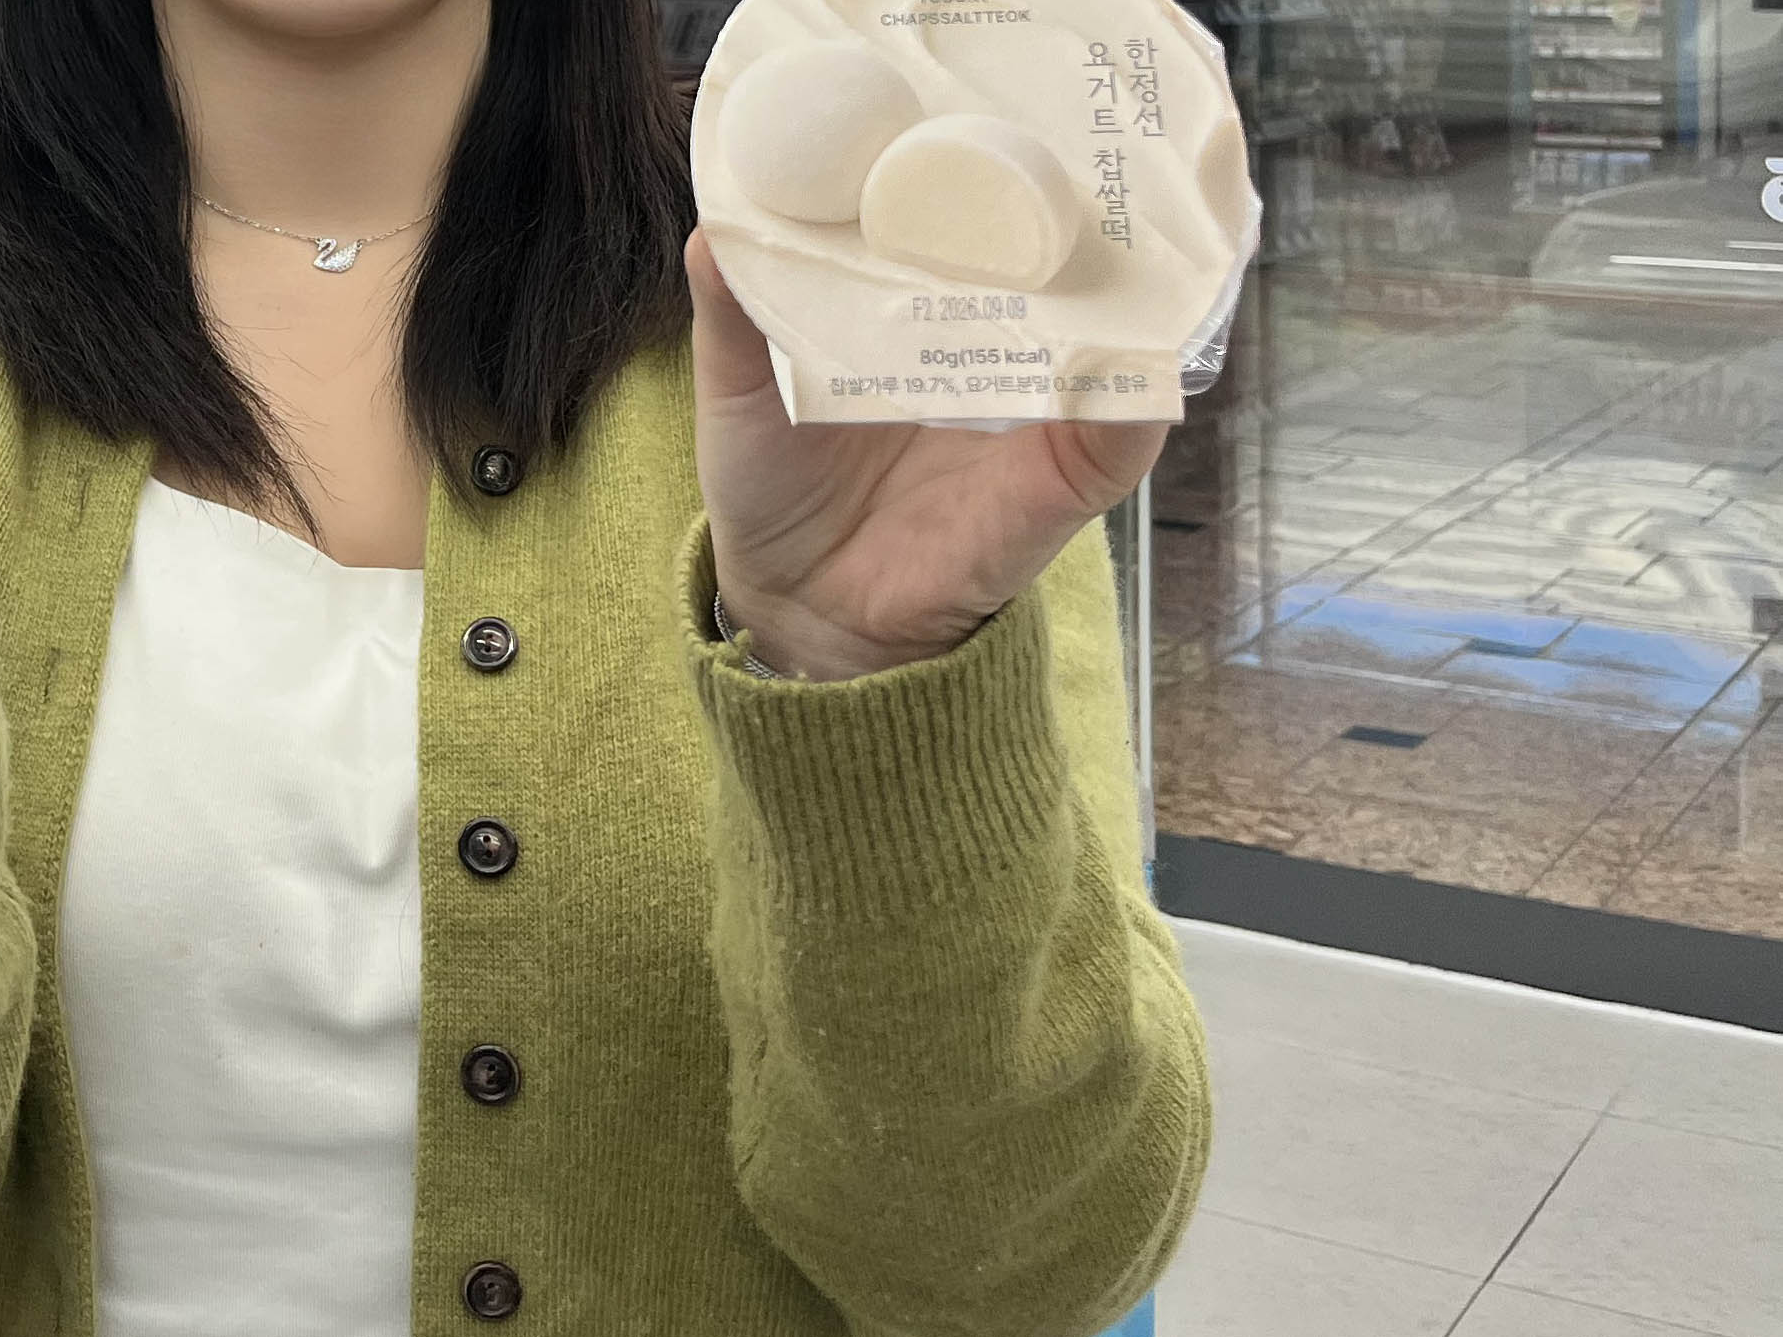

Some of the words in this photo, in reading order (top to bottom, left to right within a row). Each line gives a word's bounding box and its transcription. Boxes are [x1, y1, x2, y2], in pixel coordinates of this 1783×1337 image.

[1082, 42, 1125, 134] 요거트
[1124, 37, 1166, 137] 한정선
[1093, 148, 1132, 250] 찹쌀떡
[912, 297, 933, 321] F2
[830, 375, 899, 396] 찹쌀가루
[905, 376, 962, 397] 19.7%,
[965, 374, 1052, 395] 요거트분말
[1113, 373, 1149, 394] 함유
[920, 349, 1001, 369] 80g(155
[1004, 347, 1052, 367] kcal)
